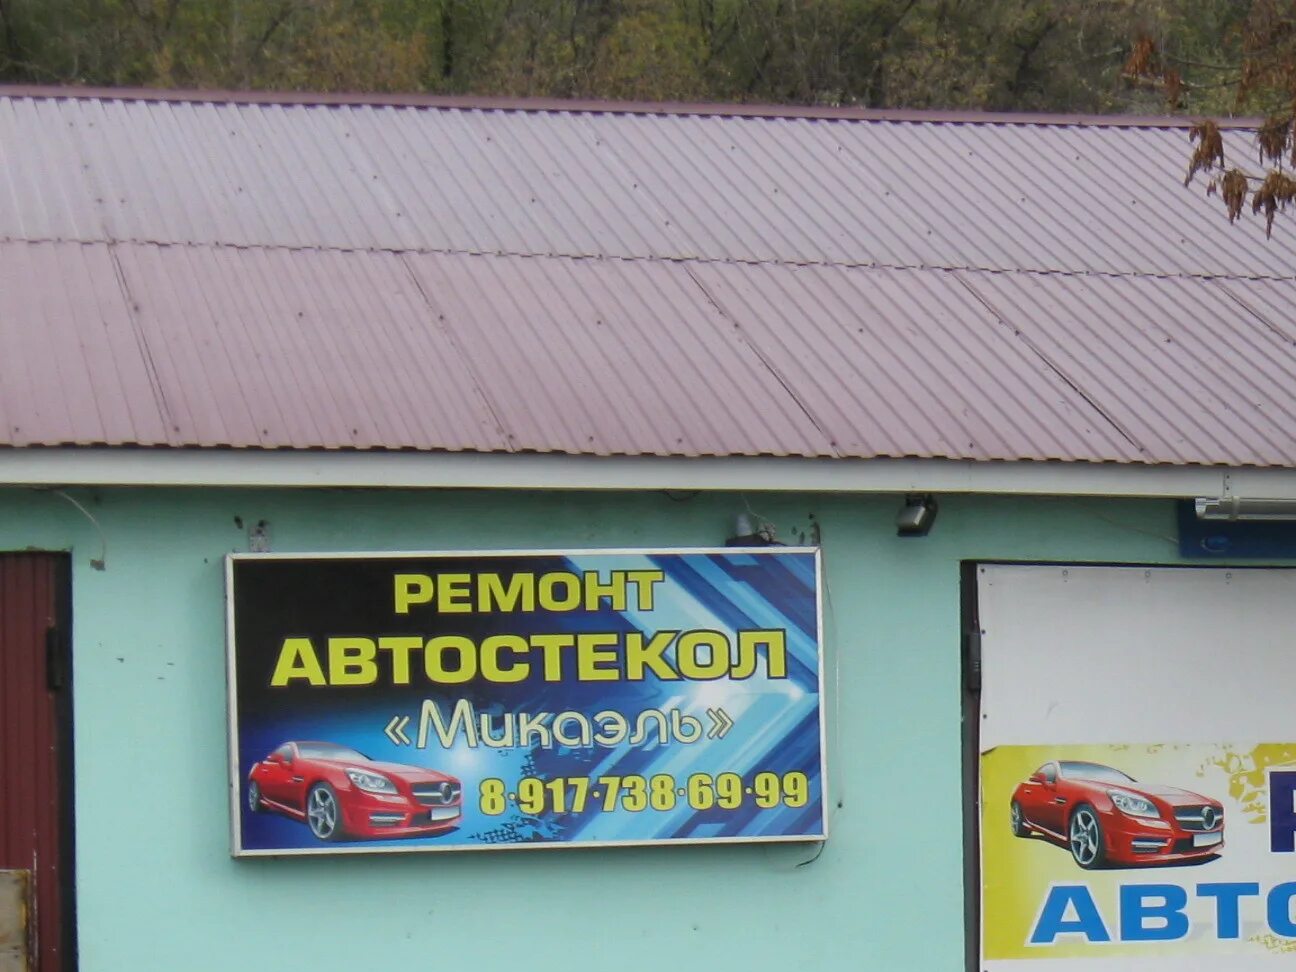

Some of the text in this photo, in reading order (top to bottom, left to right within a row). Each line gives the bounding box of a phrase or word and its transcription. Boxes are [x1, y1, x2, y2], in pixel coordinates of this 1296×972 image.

[394, 571, 663, 615] РЕМОНТ
[269, 629, 788, 687] АВТОСТЕКОЛ
[384, 698, 734, 749] «Микаэль»
